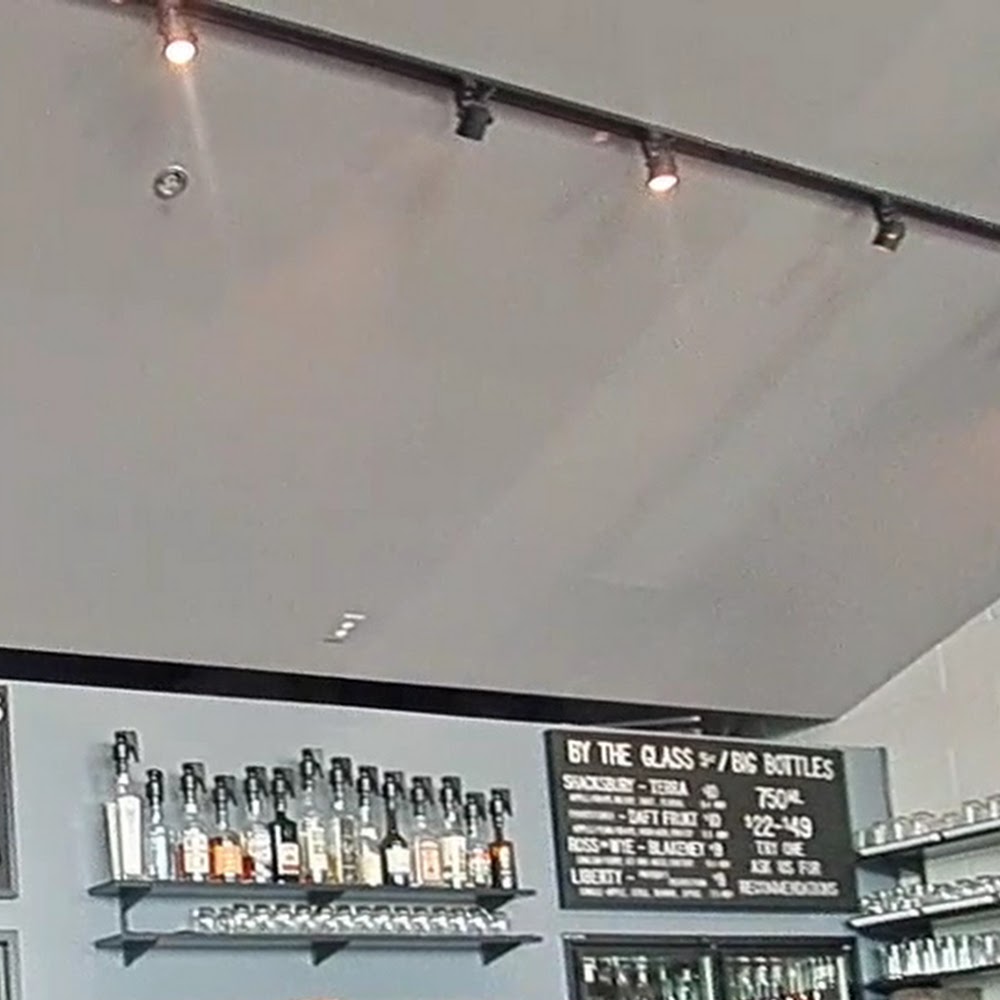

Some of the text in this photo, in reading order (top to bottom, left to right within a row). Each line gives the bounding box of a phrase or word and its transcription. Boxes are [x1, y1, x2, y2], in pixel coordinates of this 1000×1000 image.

[567, 740, 591, 763] BY
[597, 742, 632, 766] THE
[641, 745, 694, 770] GLASS
[731, 751, 757, 774] BIG
[763, 754, 834, 780] BOTTLES
